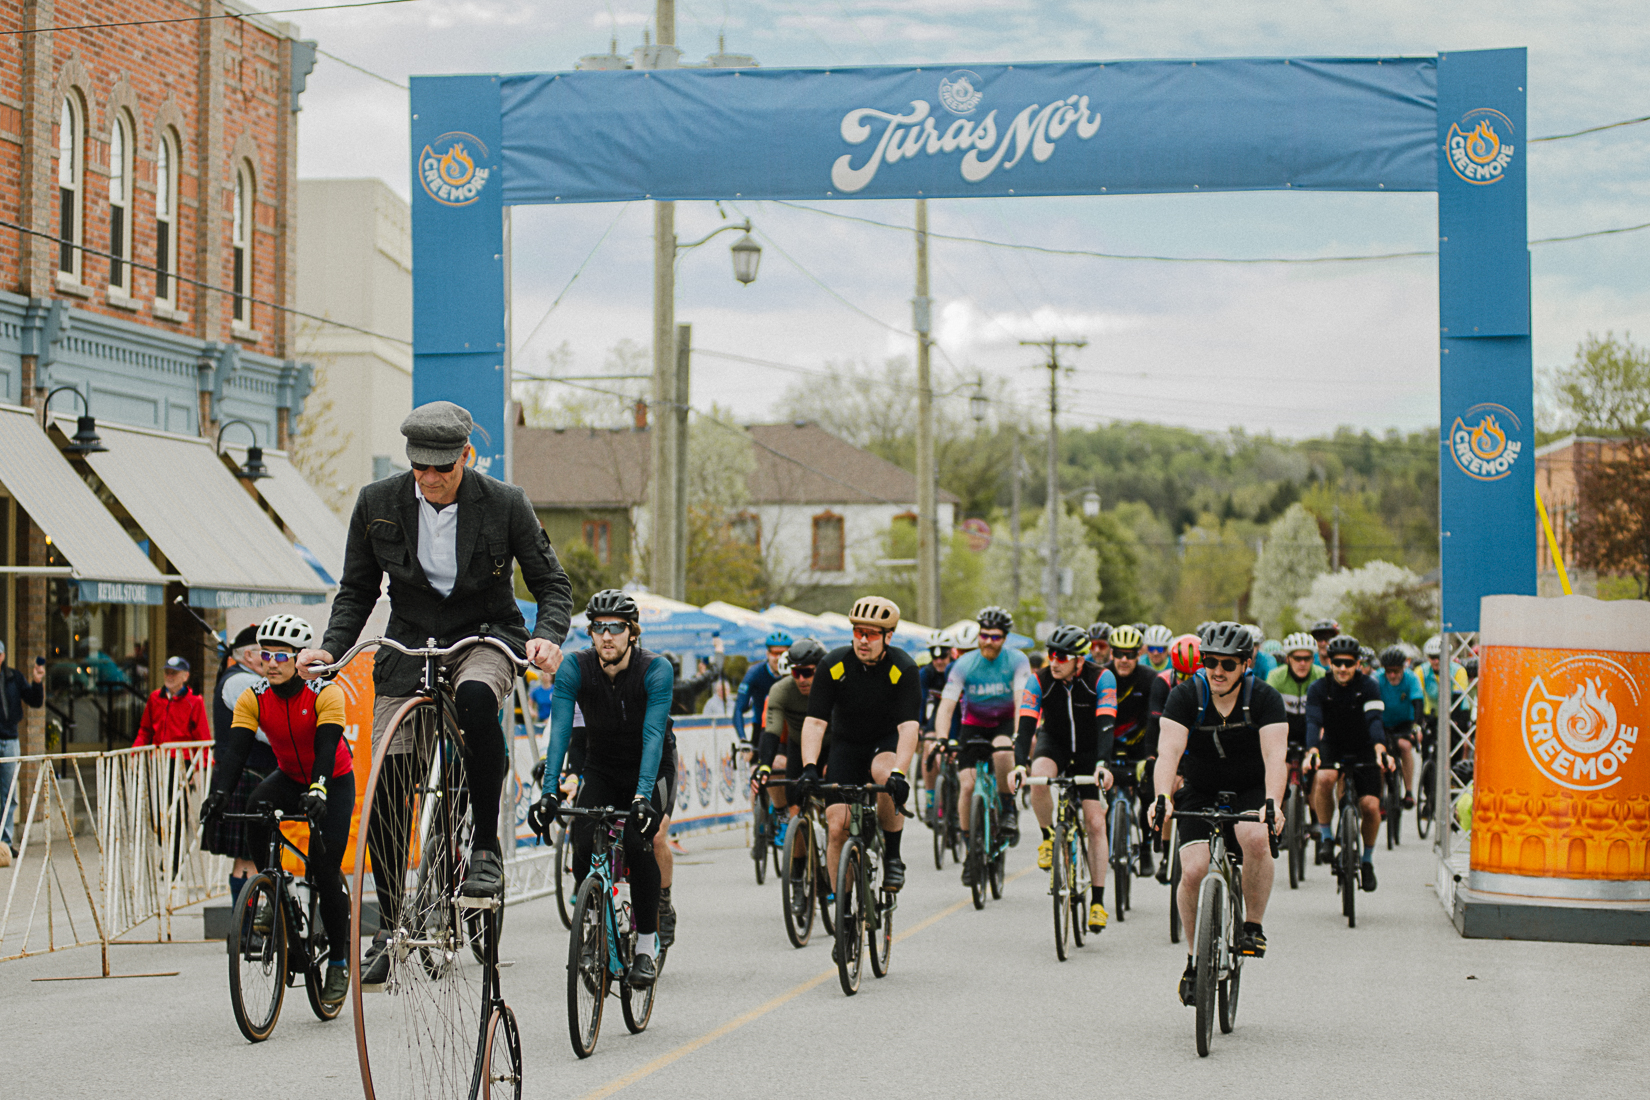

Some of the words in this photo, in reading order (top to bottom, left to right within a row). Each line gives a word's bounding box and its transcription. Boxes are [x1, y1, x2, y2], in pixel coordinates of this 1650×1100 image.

[942, 85, 983, 110] CREEMORE
[831, 99, 998, 193] Turas
[960, 94, 1102, 183] Mór
[1450, 136, 1515, 180] CREEMORE
[424, 158, 490, 201] CREEMORE
[1454, 430, 1522, 476] CREEMORE
[98, 582, 123, 601] RETAIL
[123, 584, 147, 602] STORE
[1530, 701, 1639, 781] CREEMORE
